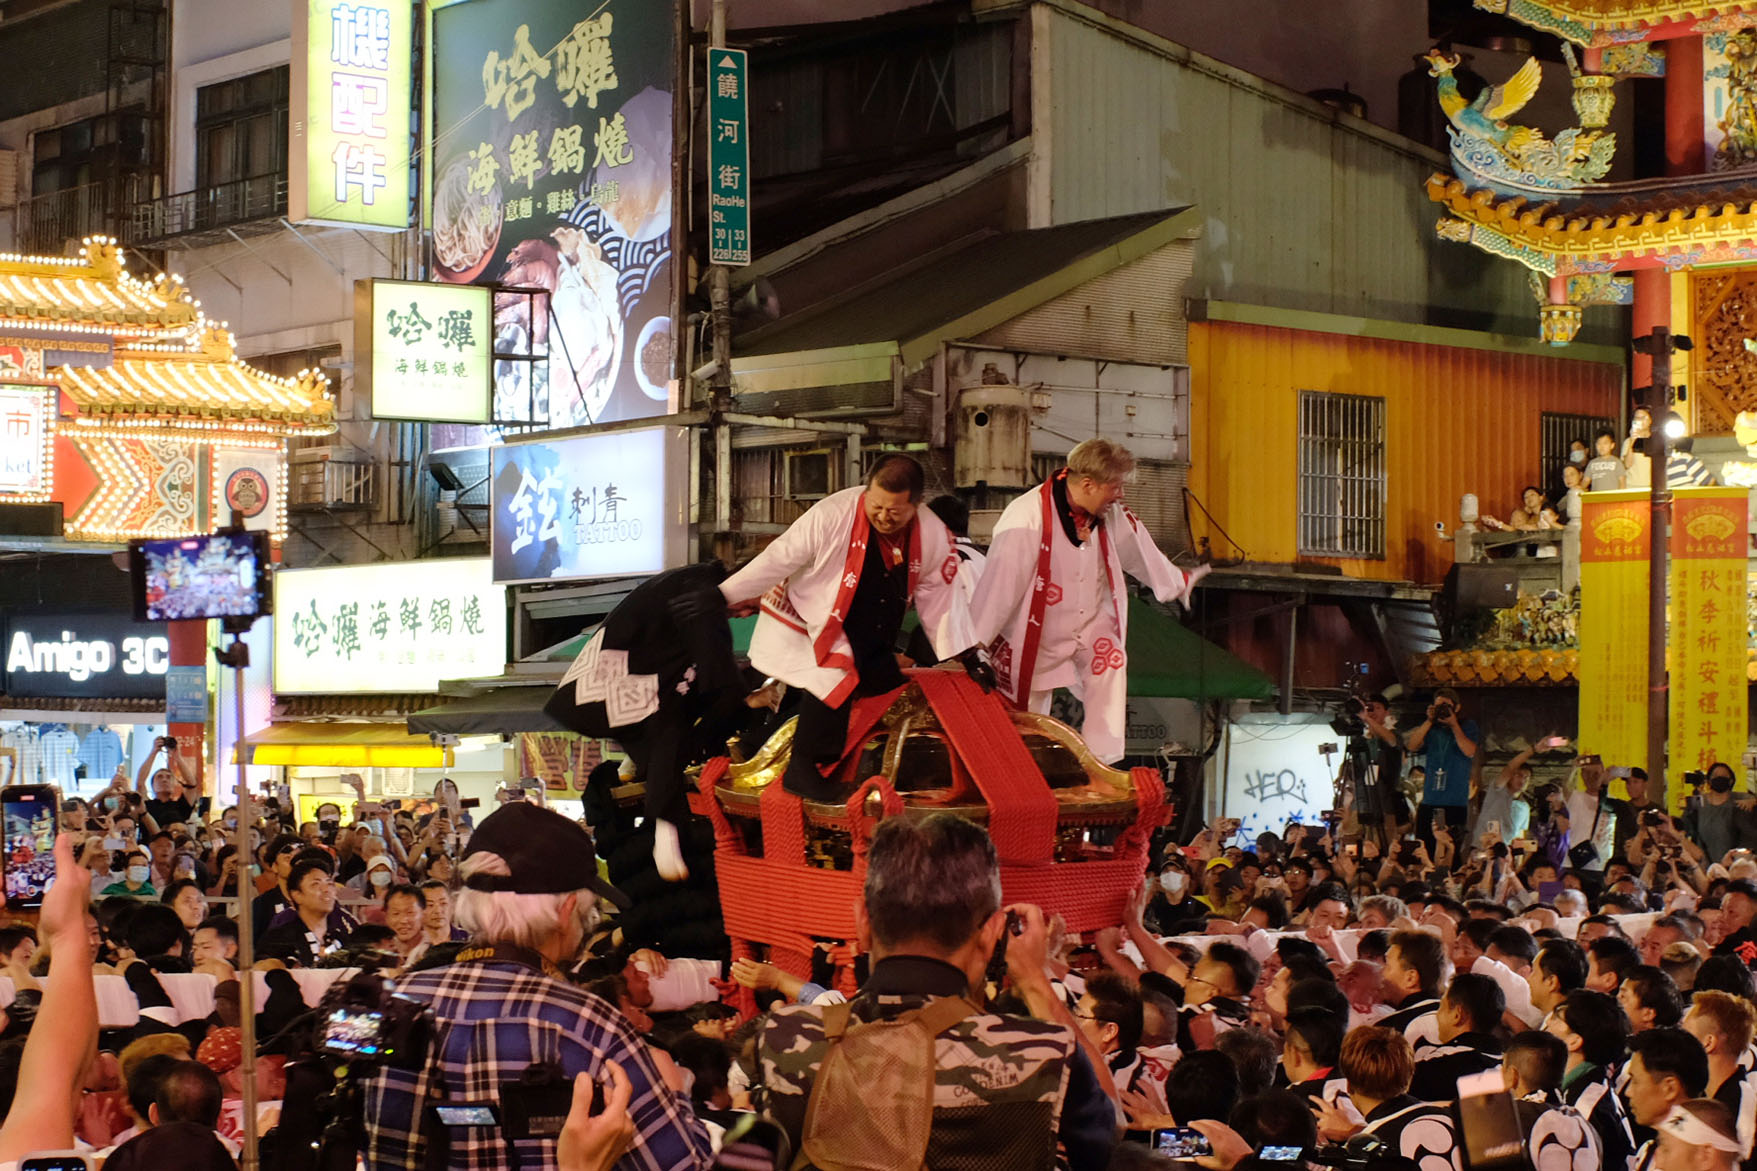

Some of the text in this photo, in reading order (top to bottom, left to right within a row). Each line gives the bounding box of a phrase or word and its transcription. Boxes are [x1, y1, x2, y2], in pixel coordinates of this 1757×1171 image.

[331, 3, 390, 205] 機配件
[717, 73, 741, 189] 饒河街
[467, 112, 634, 196] 海鮮鍋燒
[712, 193, 746, 208] RaoHe
[715, 228, 745, 241] 30 33
[713, 248, 748, 261] 226 255
[387, 301, 476, 353] 哈囉
[394, 358, 469, 378] 海鮮鍋燒
[1591, 461, 1617, 471] FOCUS
[568, 482, 628, 526] 刺青
[573, 518, 643, 546] TATTOO
[7, 631, 170, 682] Amigo 3C
